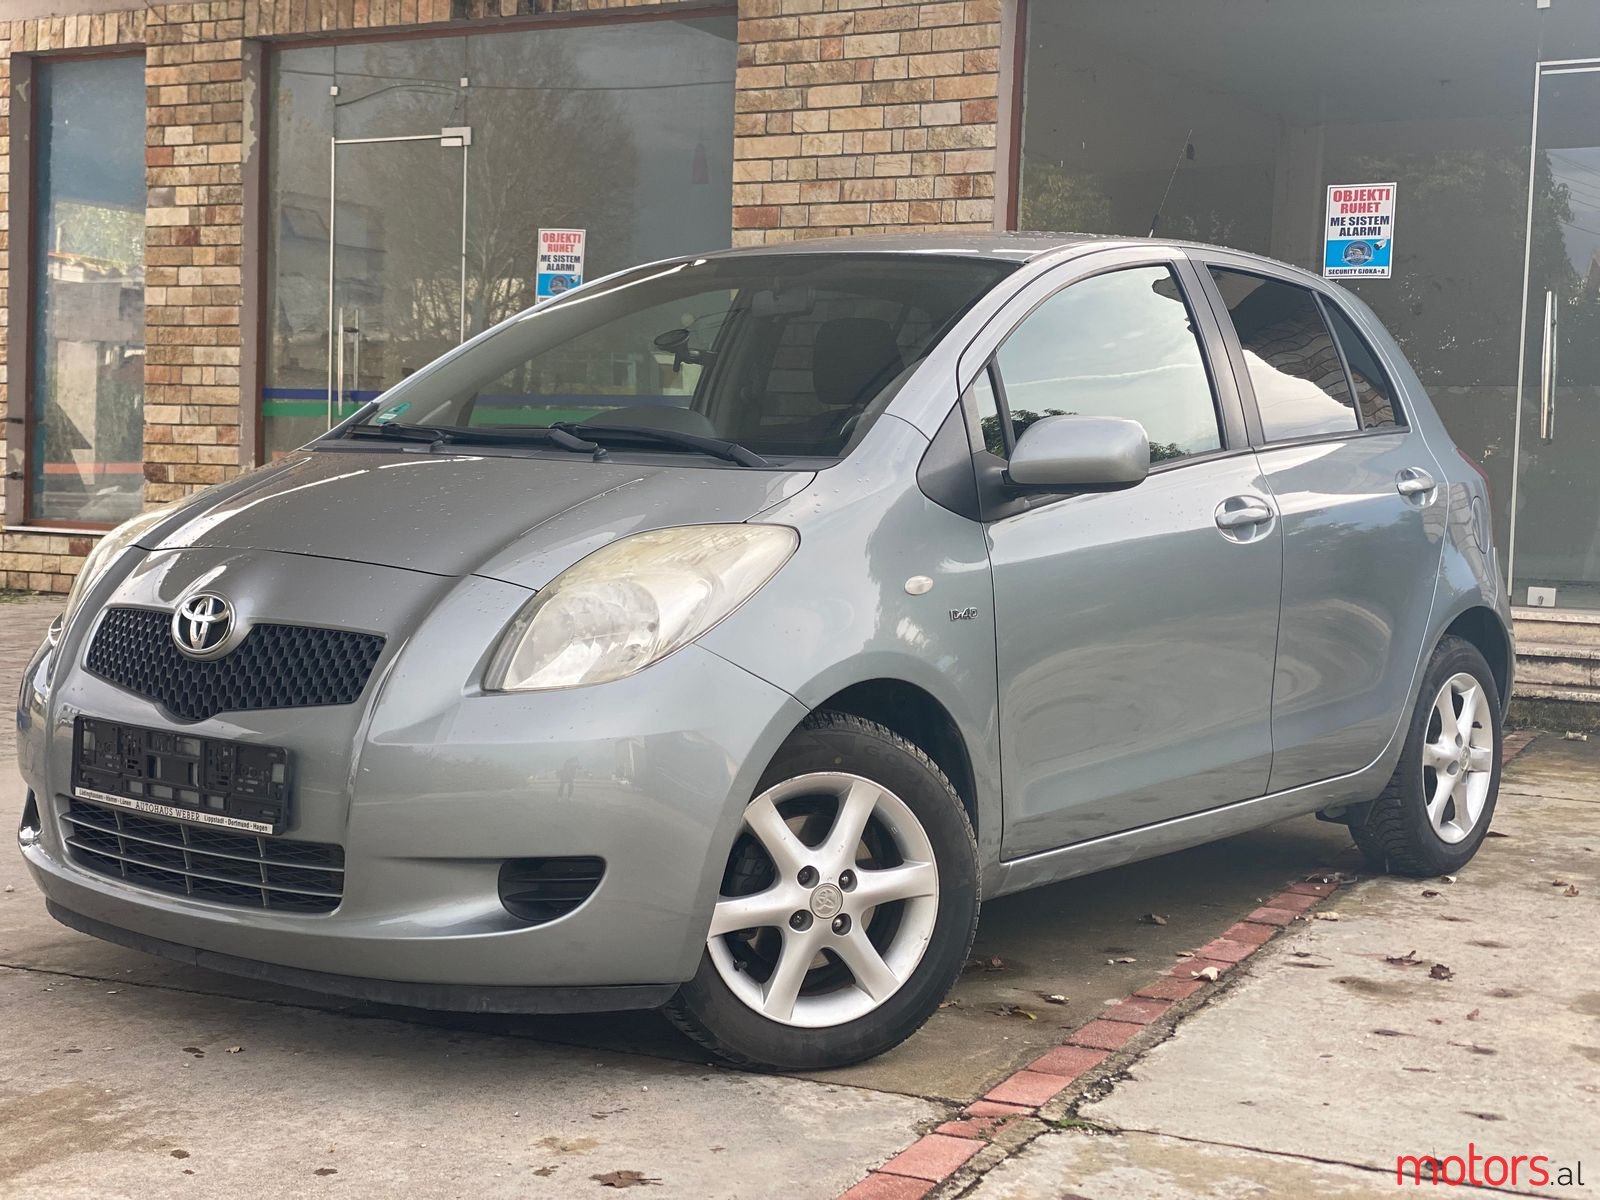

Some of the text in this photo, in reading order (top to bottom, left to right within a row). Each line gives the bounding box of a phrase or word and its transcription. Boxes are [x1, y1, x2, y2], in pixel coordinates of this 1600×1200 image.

[1333, 188, 1390, 202] OBJEKTI
[1340, 202, 1381, 214] RUHET
[1330, 215, 1390, 226] ME SISTEM
[1339, 226, 1381, 236] ALARMI
[543, 233, 581, 243] OBJEKTI
[547, 243, 575, 253] RUHET
[541, 254, 581, 263] ME SISTEM
[546, 263, 575, 271] ALARMI
[135, 801, 173, 816] AUTOHAUS
[175, 809, 200, 821] WEBER
[227, 818, 249, 829] Dortmund
[253, 823, 268, 832] Hagen
